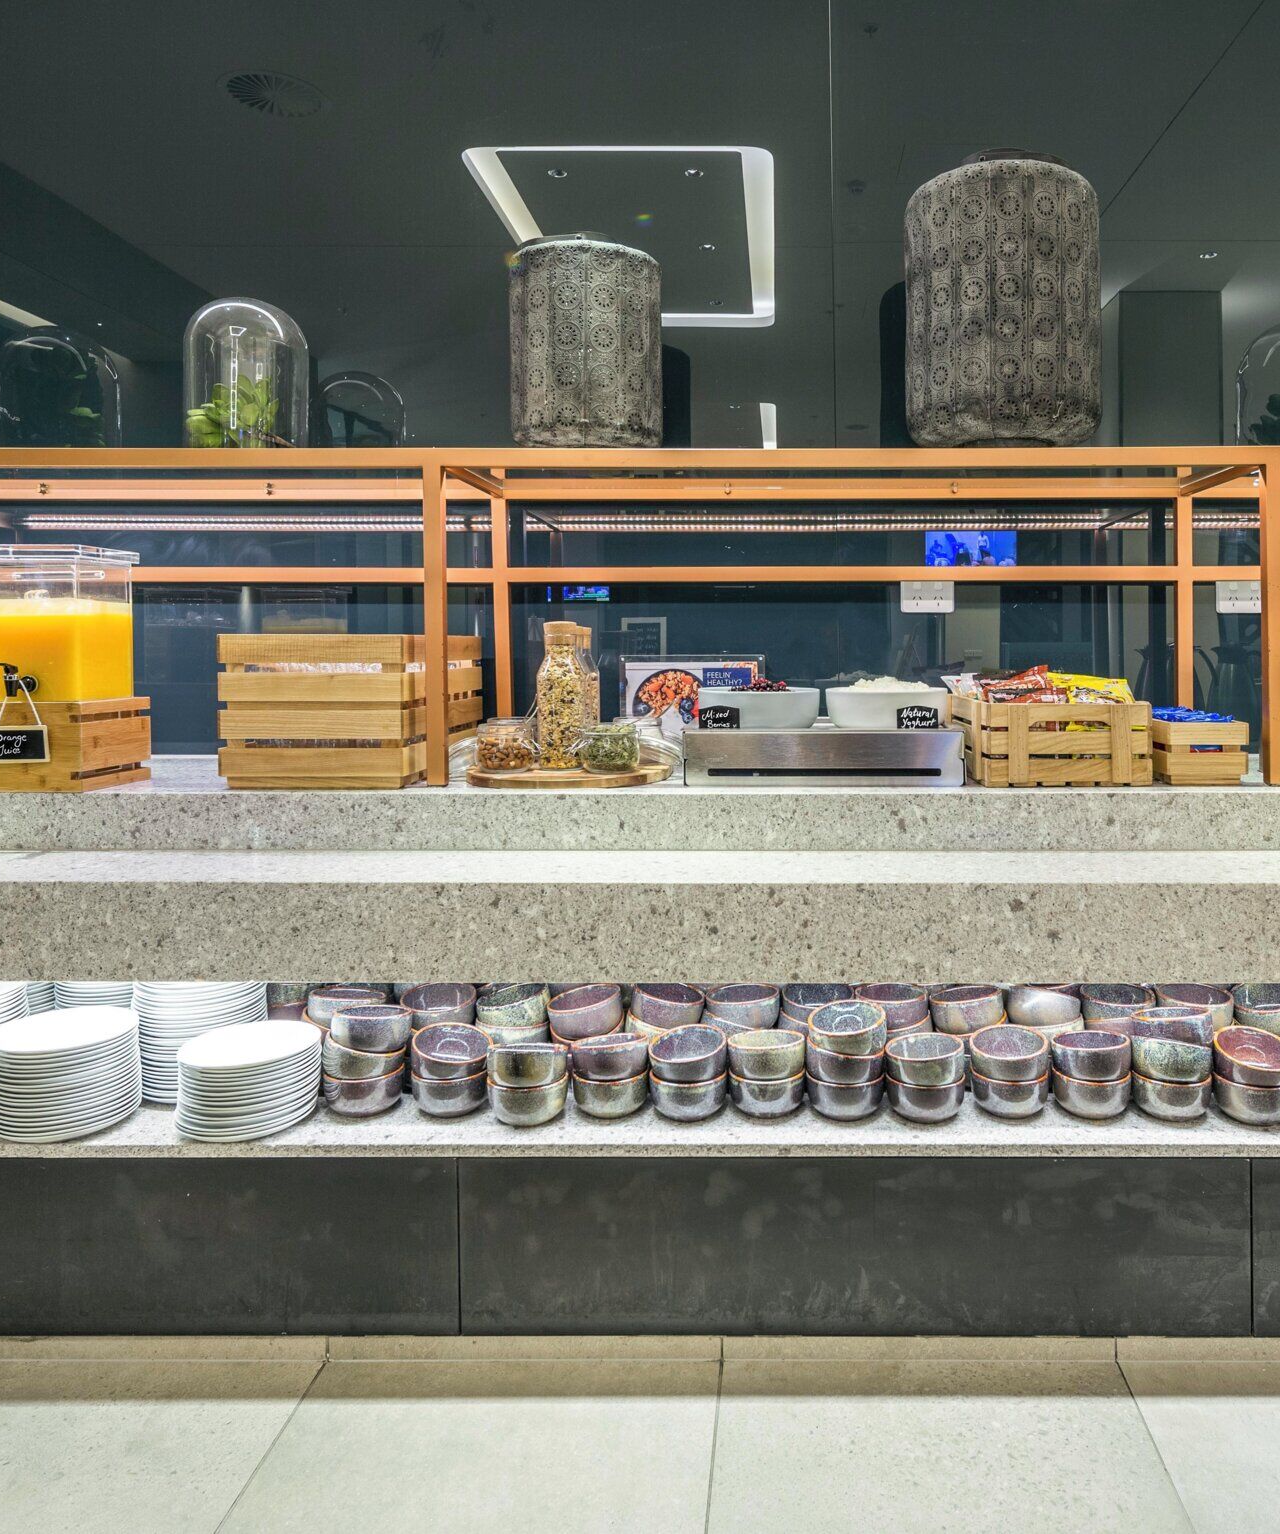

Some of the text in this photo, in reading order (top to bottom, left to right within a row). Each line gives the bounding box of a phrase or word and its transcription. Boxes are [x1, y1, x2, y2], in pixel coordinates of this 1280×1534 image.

[702, 710, 730, 720] Mixed
[900, 708, 934, 718] Natural
[707, 720, 730, 728] Berries
